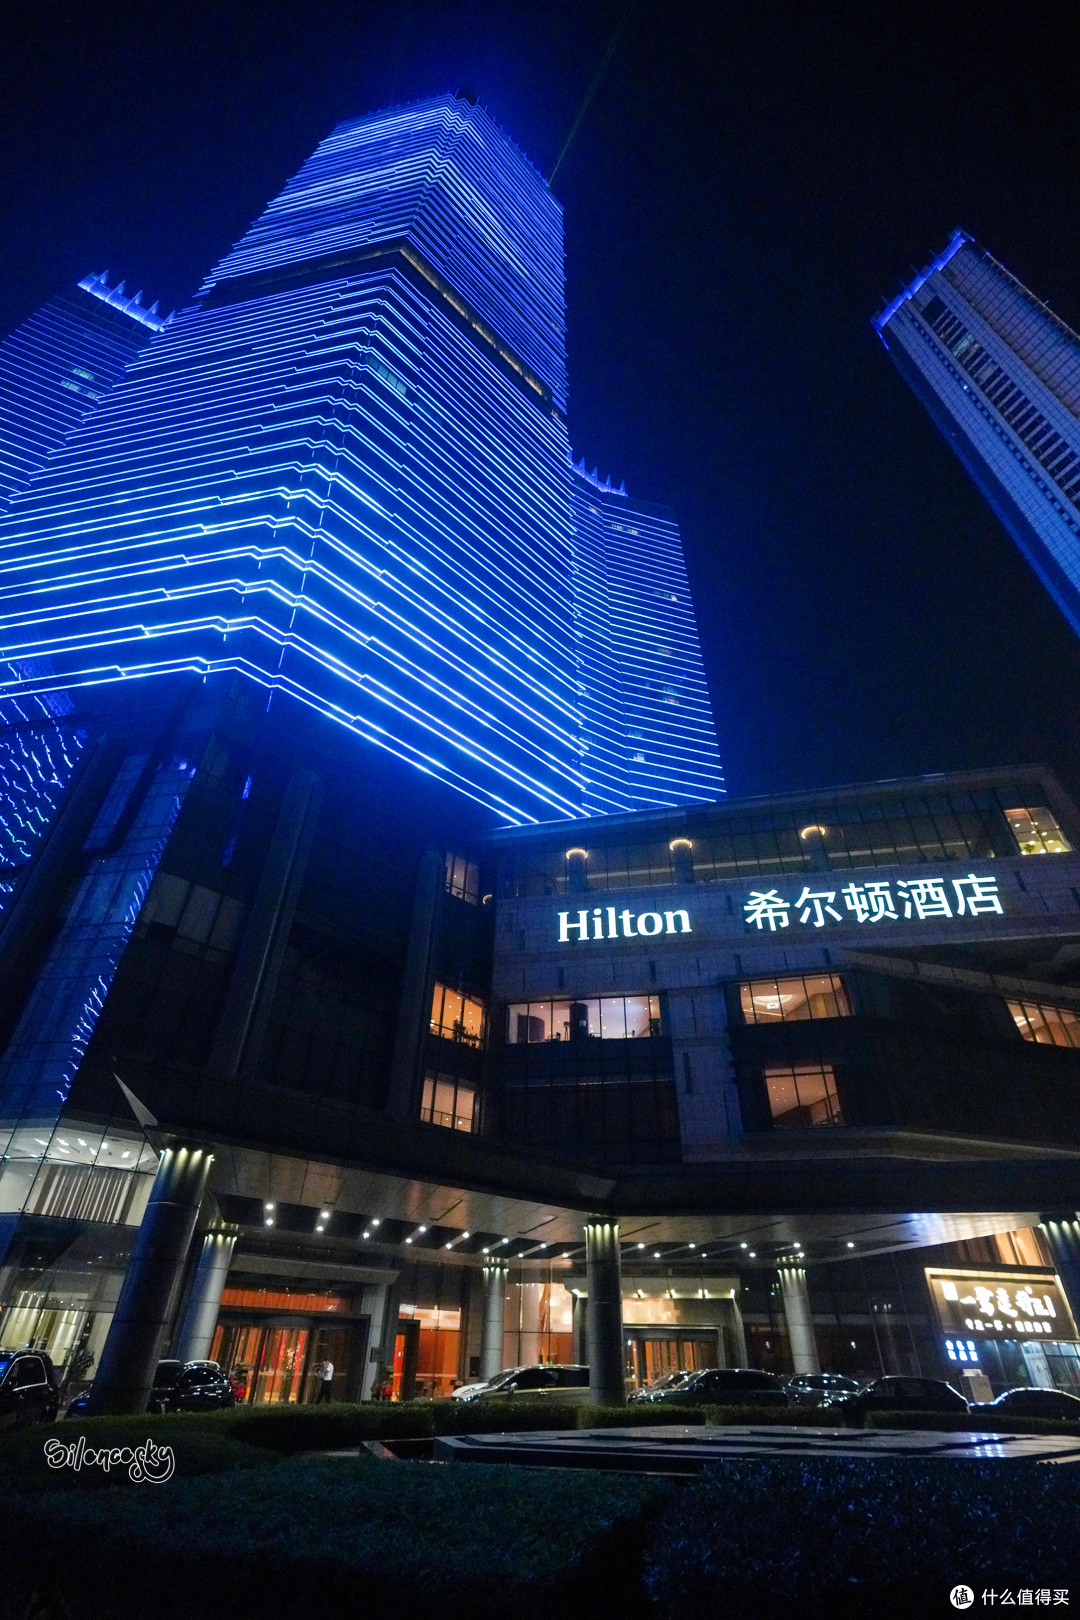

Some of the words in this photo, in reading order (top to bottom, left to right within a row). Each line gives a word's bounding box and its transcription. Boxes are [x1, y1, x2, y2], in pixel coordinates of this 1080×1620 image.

[557, 906, 693, 943] Hilton
[743, 873, 1004, 932] 希尔顿酒店
